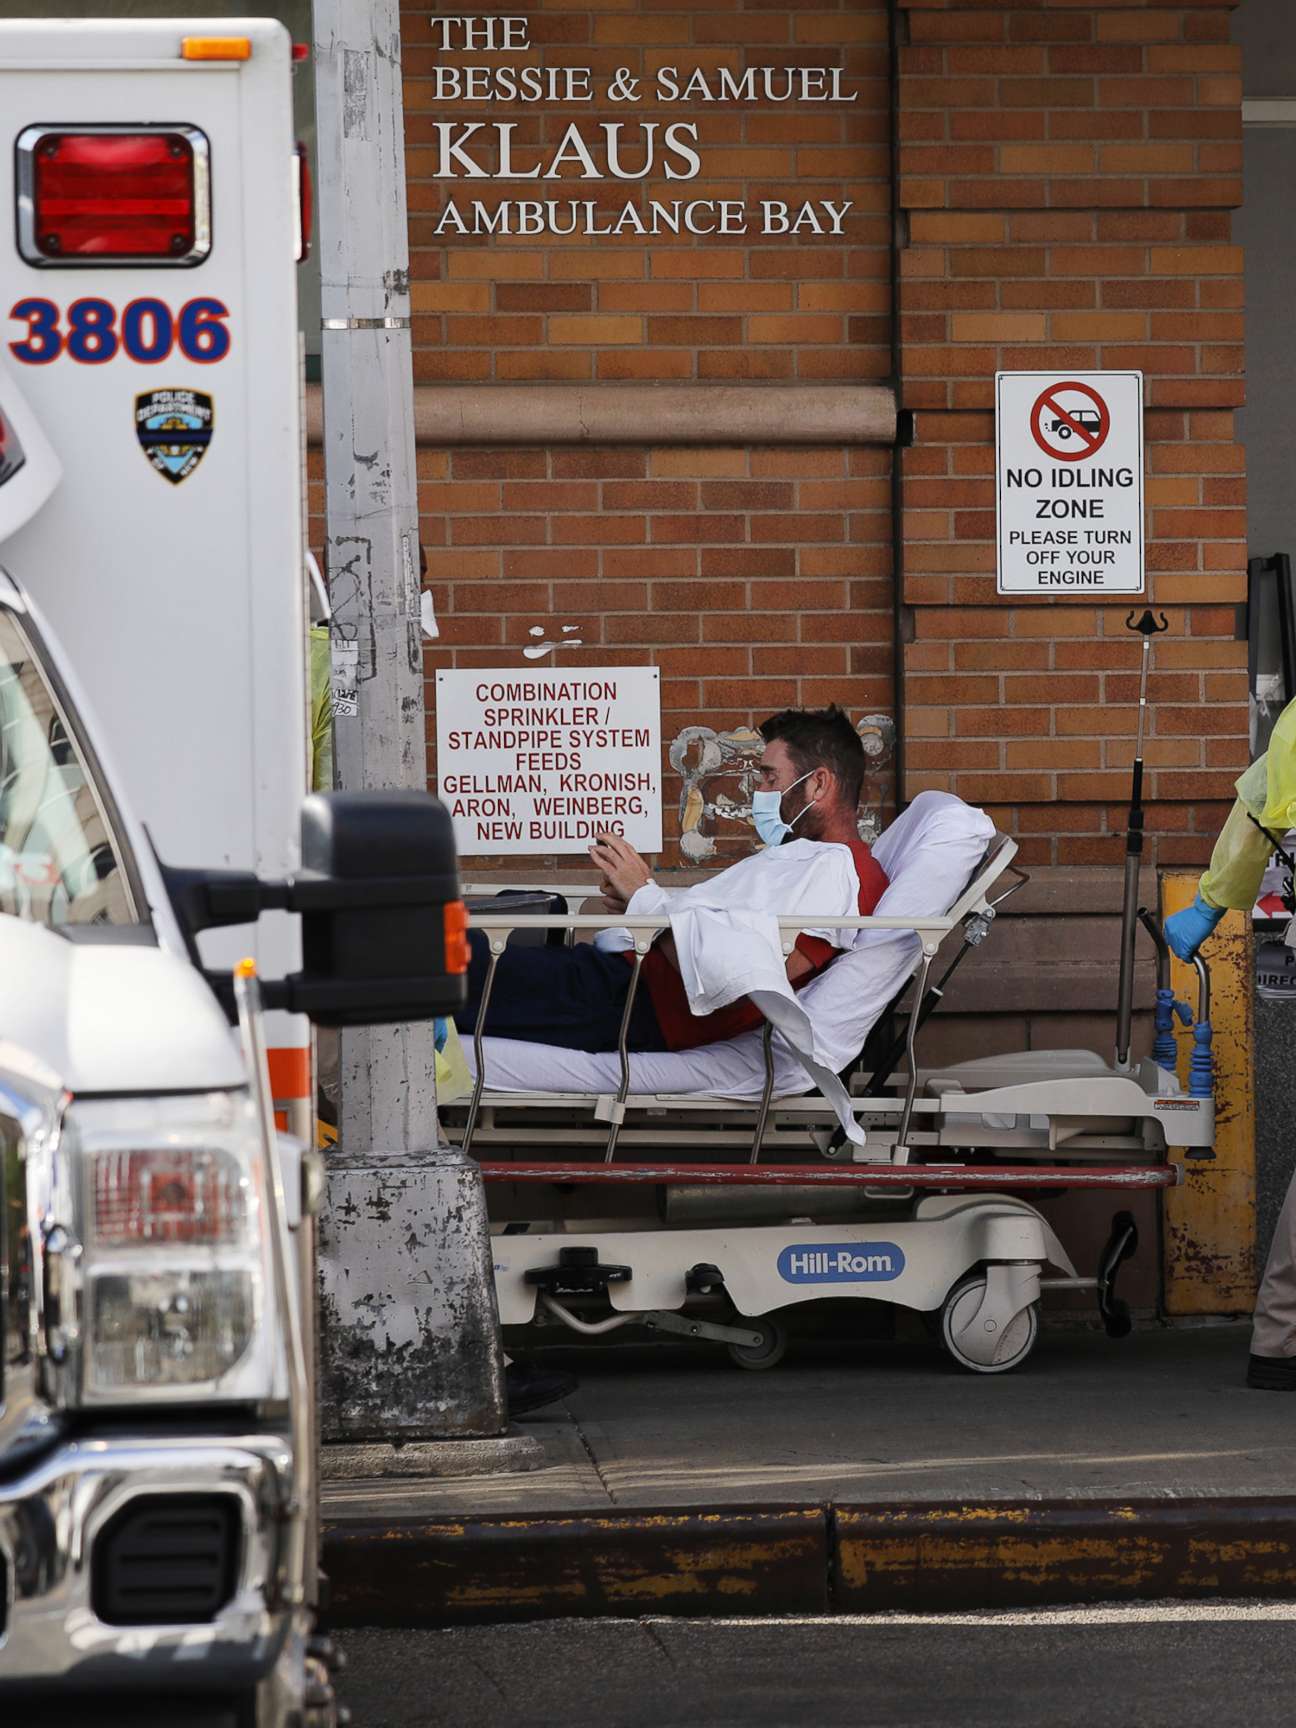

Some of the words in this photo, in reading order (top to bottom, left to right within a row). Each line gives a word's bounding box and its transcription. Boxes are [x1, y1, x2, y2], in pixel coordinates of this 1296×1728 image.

[431, 17, 530, 51] THE
[432, 66, 594, 101] BESSIE
[607, 66, 642, 101] &
[656, 66, 858, 101] SAMUEL
[432, 122, 701, 180] KLAUS
[433, 200, 748, 236] AMBULANCE
[760, 200, 854, 236] BAY
[8, 296, 231, 366] 3806
[1007, 468, 1043, 488] NO
[1052, 468, 1133, 488] IDLING
[1036, 499, 1104, 519] ZONE
[1009, 530, 1078, 545] PLEASE
[1084, 530, 1132, 545] TURN
[1026, 550, 1060, 565] OFF
[1066, 550, 1116, 565] YOUR
[1038, 570, 1104, 585] ENGINE
[476, 682, 617, 702] COMBINATION
[484, 707, 599, 727] SPRINKLER
[604, 706, 611, 726] /
[448, 730, 562, 750] STANDPIPE
[569, 728, 650, 748] SYSTEM
[516, 752, 582, 771] FEEDS
[443, 774, 548, 796] GELLMAN,
[560, 772, 656, 794] KRONISH,
[452, 798, 517, 820] ARON,
[533, 796, 649, 818] WEINBERG,
[477, 821, 523, 841] NEW
[529, 820, 625, 840] BUILDING
[790, 1251, 893, 1275] Hill-Rom
